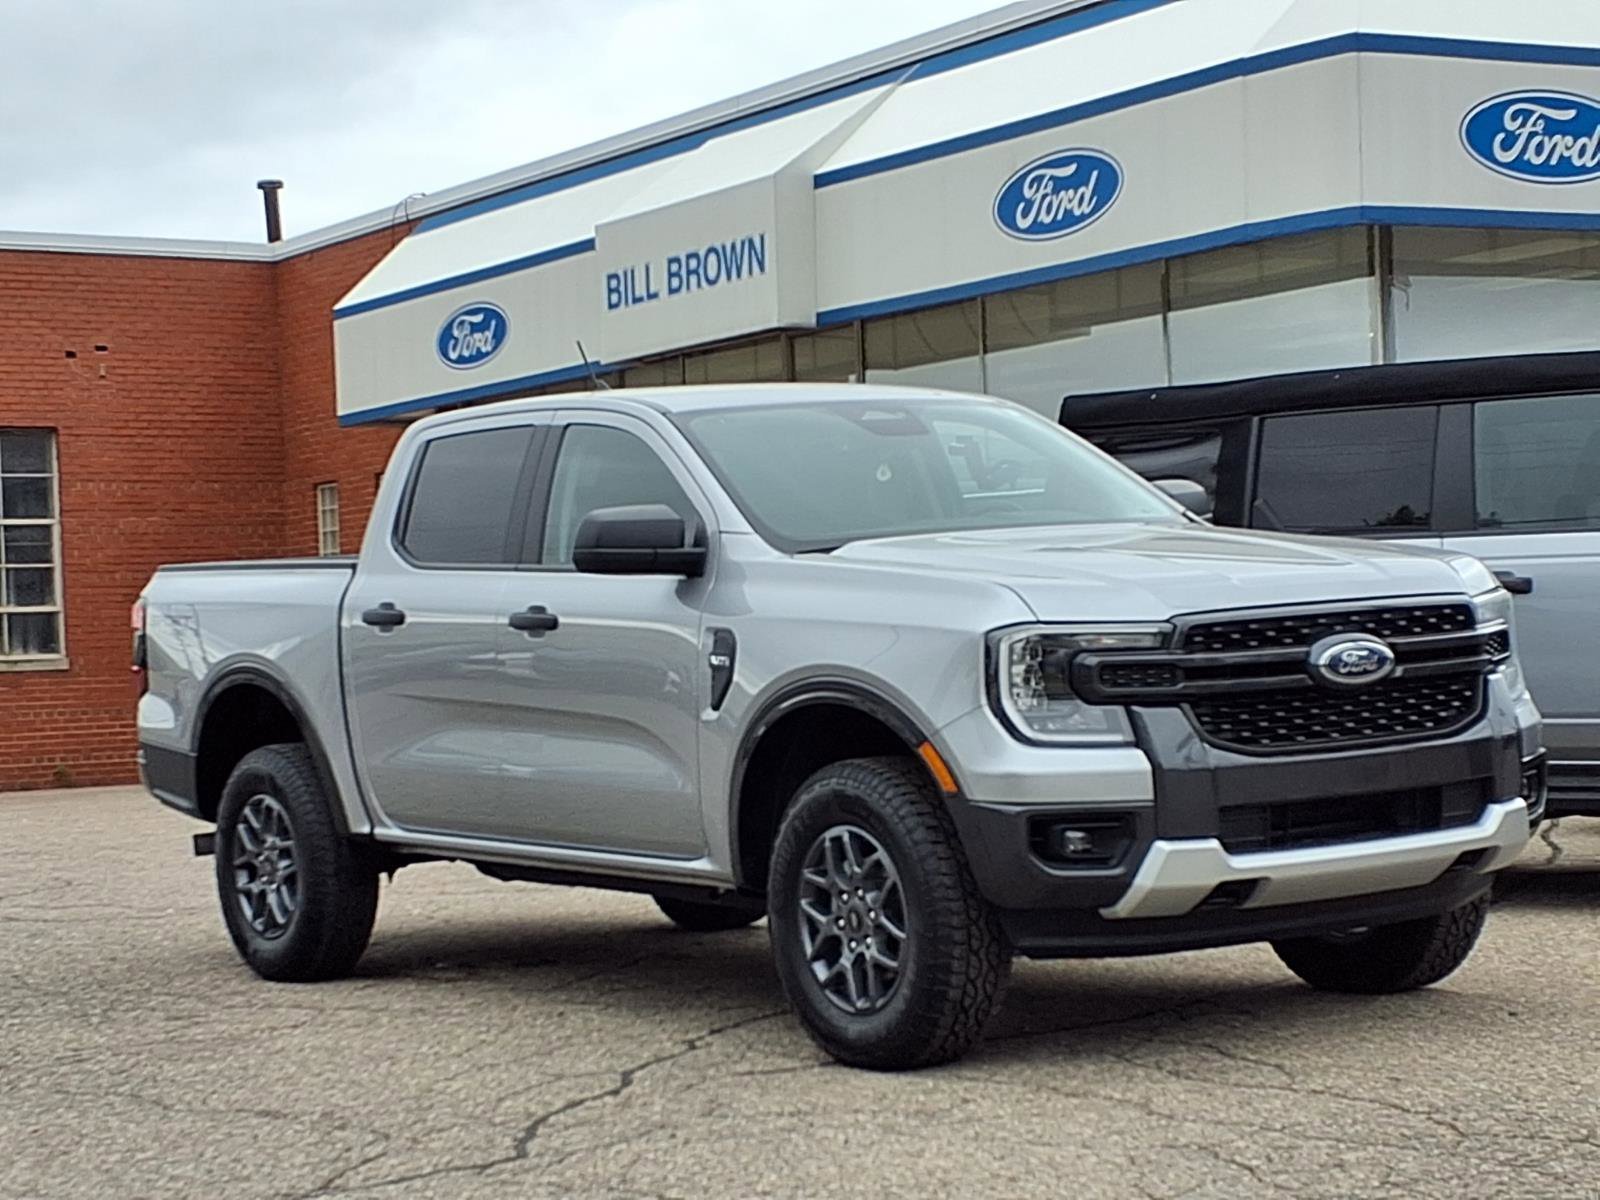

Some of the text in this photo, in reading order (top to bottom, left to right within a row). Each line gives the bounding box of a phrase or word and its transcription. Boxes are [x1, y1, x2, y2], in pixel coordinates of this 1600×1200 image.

[1493, 102, 1600, 168] Ford
[1016, 162, 1099, 230] Ford
[606, 232, 766, 311] BILL BROWN
[448, 312, 496, 360] Ford
[1339, 650, 1379, 674] Ford
